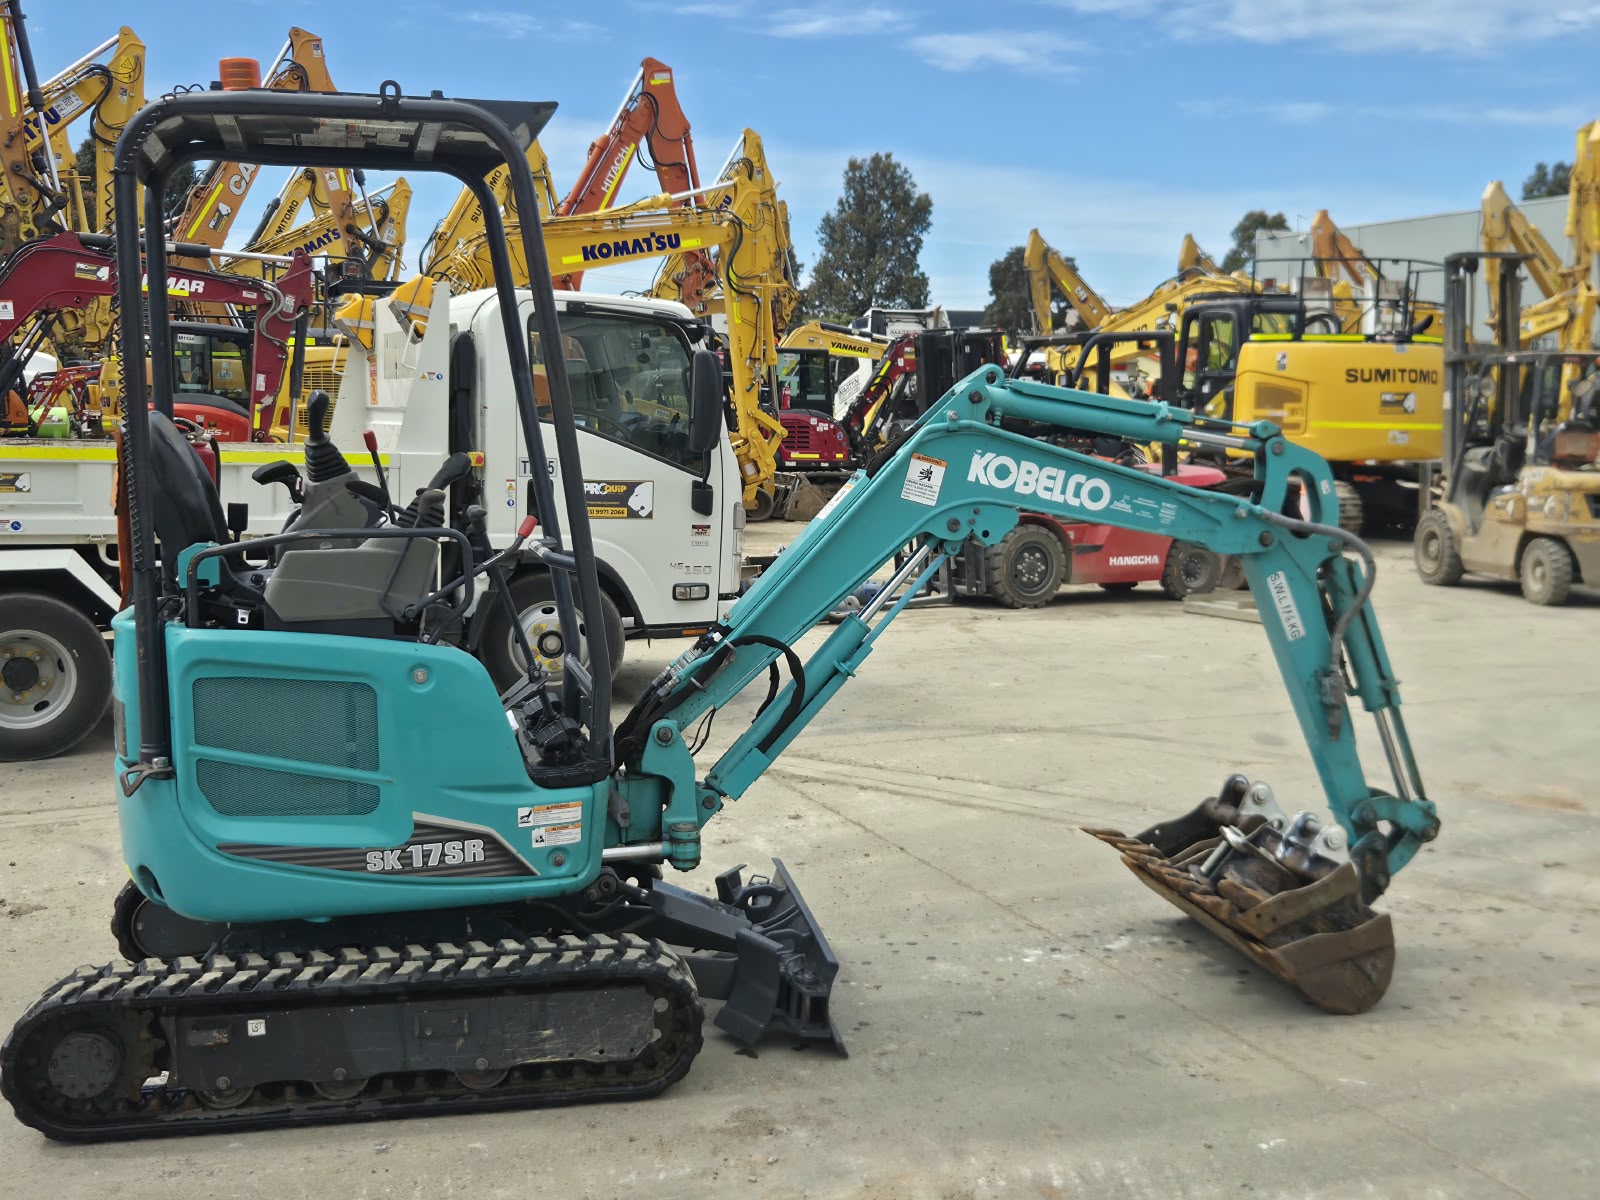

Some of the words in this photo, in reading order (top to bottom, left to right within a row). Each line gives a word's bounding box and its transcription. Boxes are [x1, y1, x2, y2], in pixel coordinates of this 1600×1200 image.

[229, 162, 257, 196] CA
[601, 145, 629, 193] HITACHI
[581, 232, 681, 262] KOMATSU
[830, 341, 869, 354] YANMAR
[1345, 368, 1438, 385] SUMITOMO
[967, 450, 1111, 511] KOBELCO
[1109, 555, 1159, 567] HANGCHA
[366, 849, 403, 872] SK
[405, 839, 485, 868] 17SR
